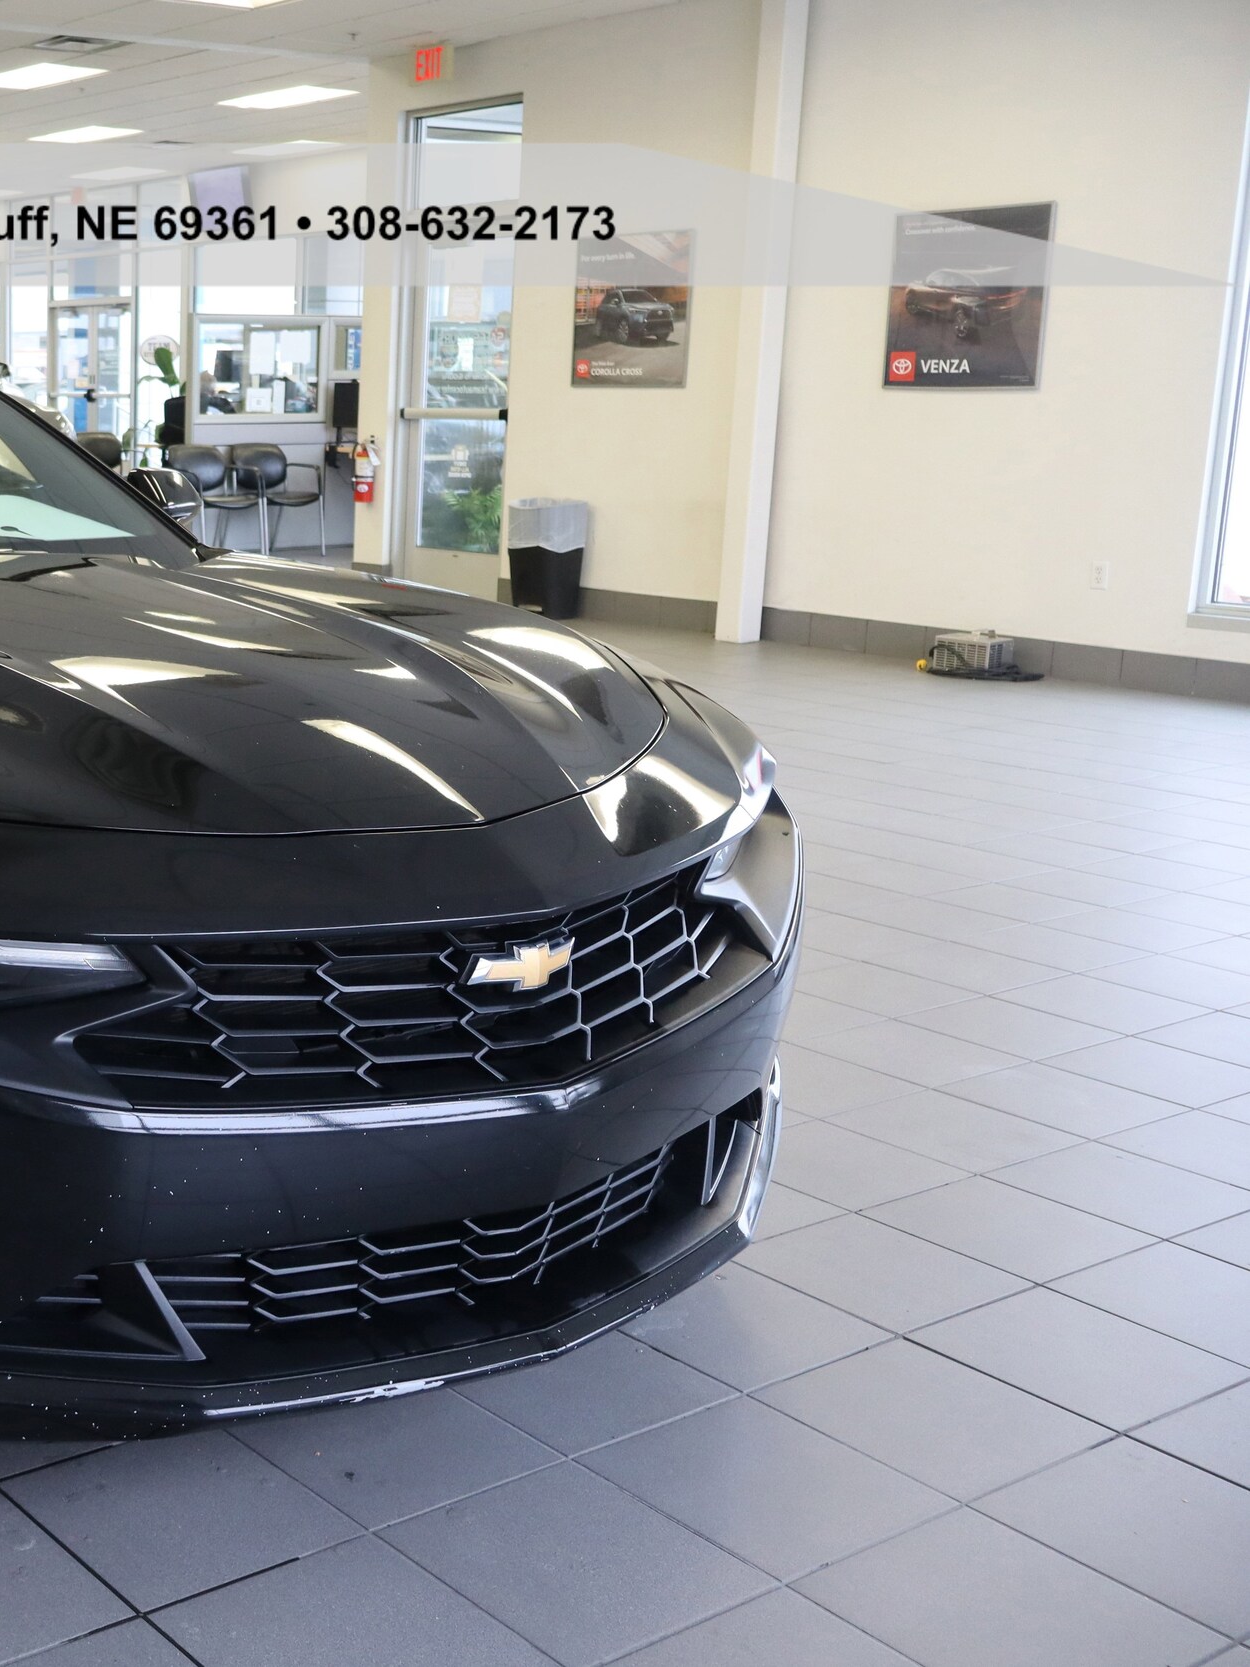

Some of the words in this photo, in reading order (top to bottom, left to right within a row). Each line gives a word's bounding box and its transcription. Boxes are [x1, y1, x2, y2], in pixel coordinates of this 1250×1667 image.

[415, 46, 443, 82] EXIT
[591, 367, 621, 376] COROLLA
[621, 367, 643, 376] CROSS
[921, 358, 971, 374] VENZA
